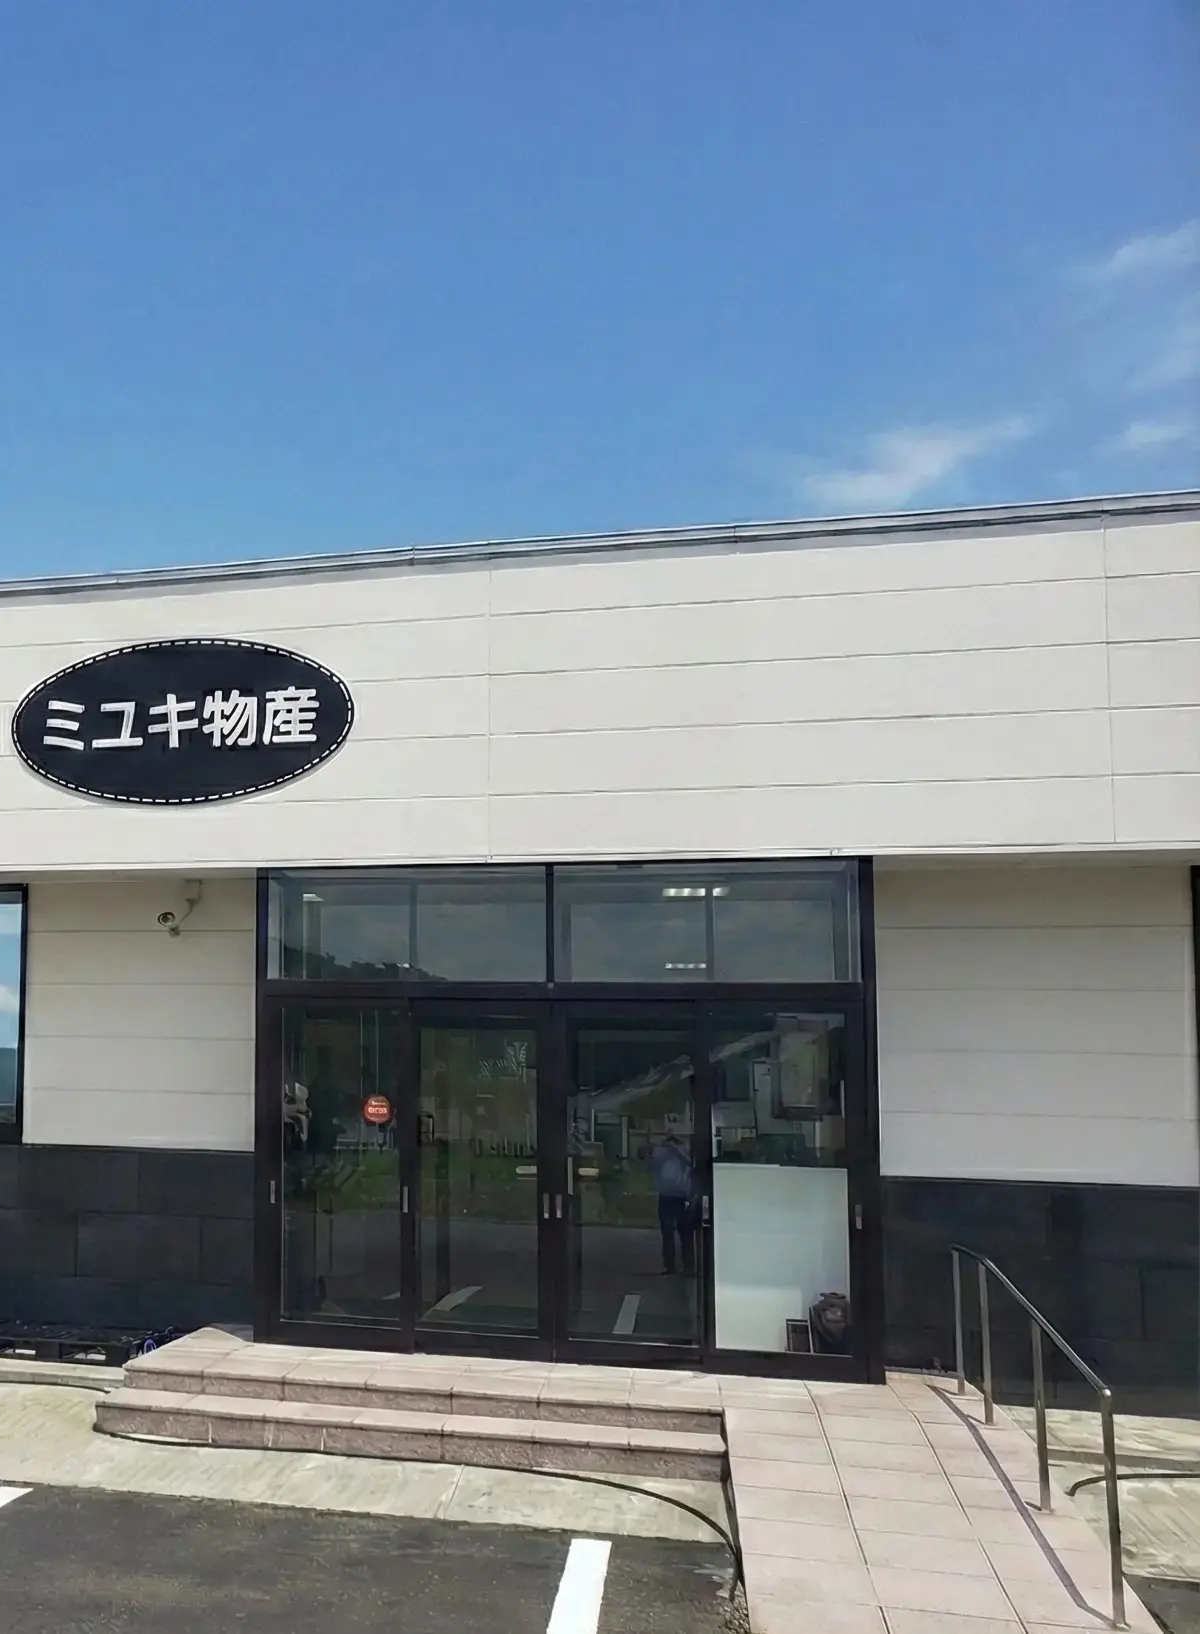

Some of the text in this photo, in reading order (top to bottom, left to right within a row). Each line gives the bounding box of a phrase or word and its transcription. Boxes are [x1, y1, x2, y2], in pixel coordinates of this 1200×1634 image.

[43, 685, 320, 751] ミユキ物産
